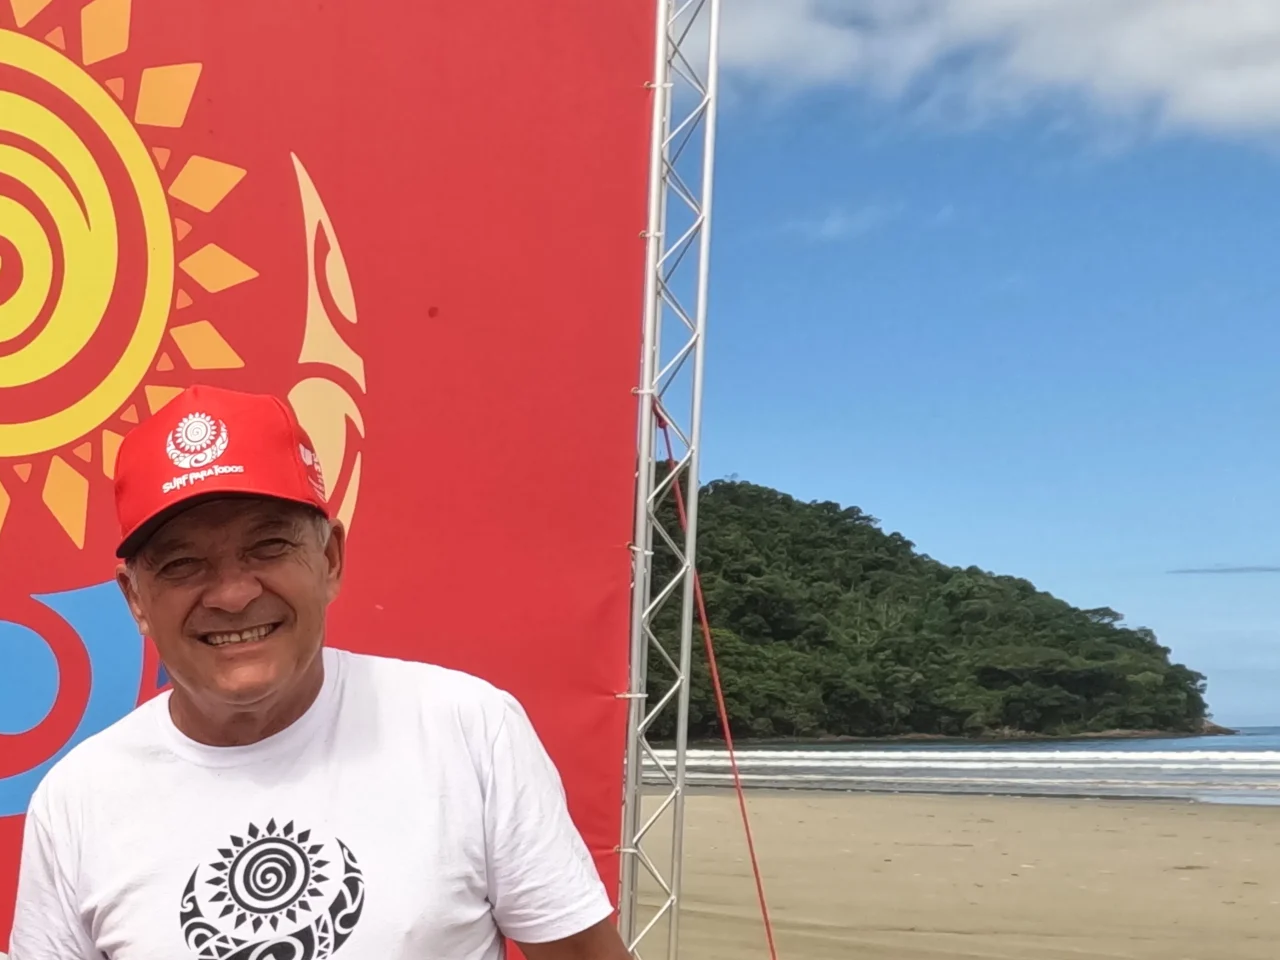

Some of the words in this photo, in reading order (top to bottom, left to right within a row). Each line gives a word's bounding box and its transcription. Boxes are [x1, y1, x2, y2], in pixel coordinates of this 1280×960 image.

[162, 474, 188, 493] SURF
[188, 468, 214, 485] PARA
[212, 465, 244, 476] TODOS
